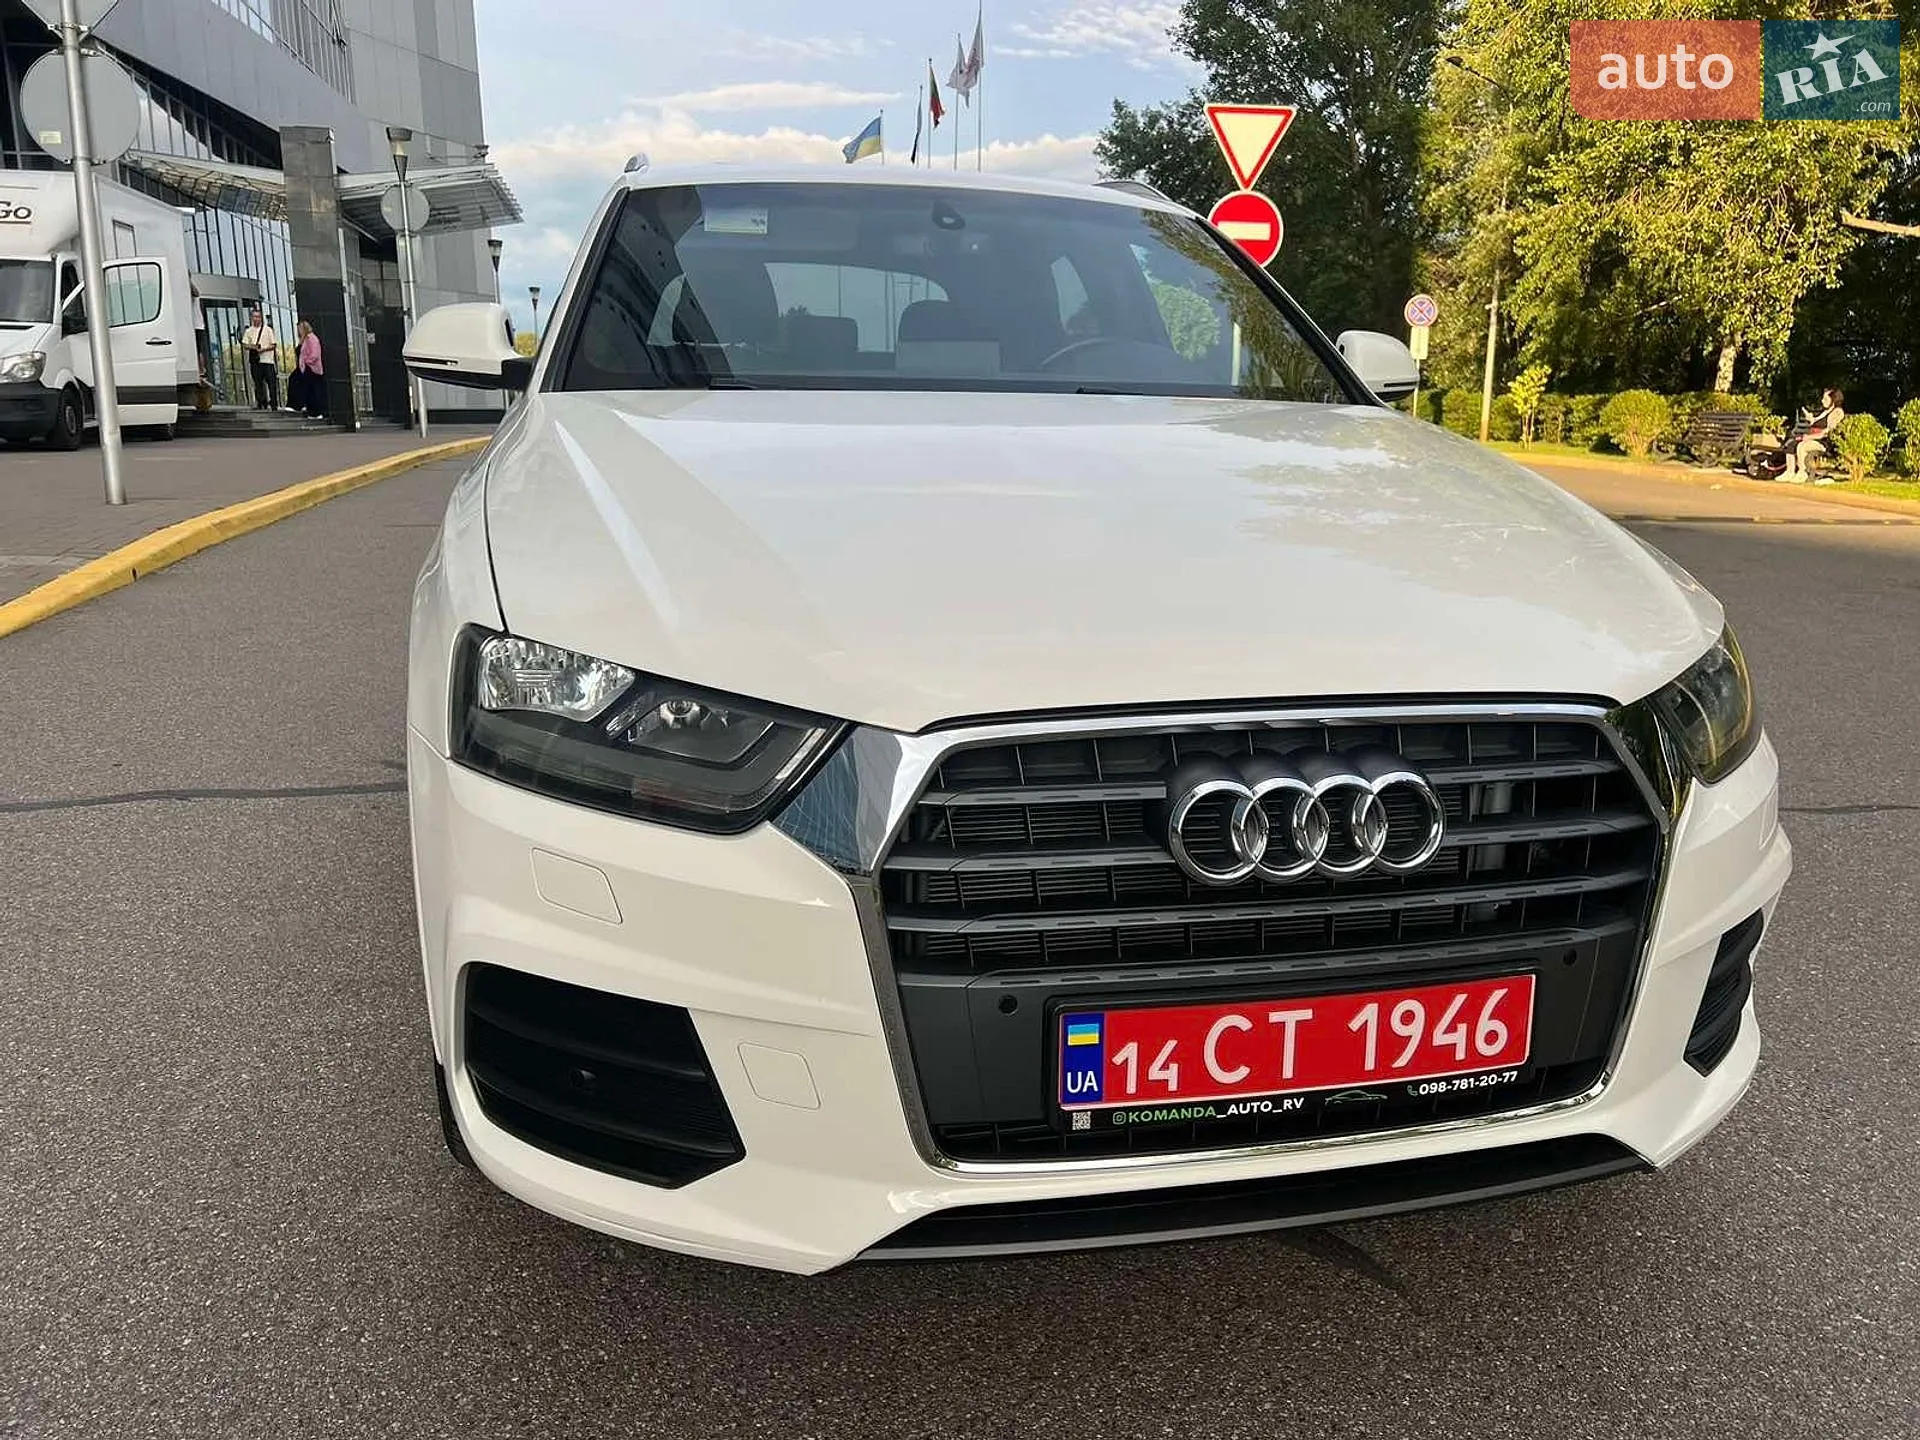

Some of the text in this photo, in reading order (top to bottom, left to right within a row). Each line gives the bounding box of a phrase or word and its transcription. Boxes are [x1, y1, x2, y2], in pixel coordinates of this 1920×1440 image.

[1111, 987, 1509, 1095] 14 CT 1946
[1066, 1070, 1099, 1094] UA
[1418, 1070, 1518, 1096] 098-781-20-77
[1128, 1097, 1305, 1123] KOMANDA_AUTO_RV
